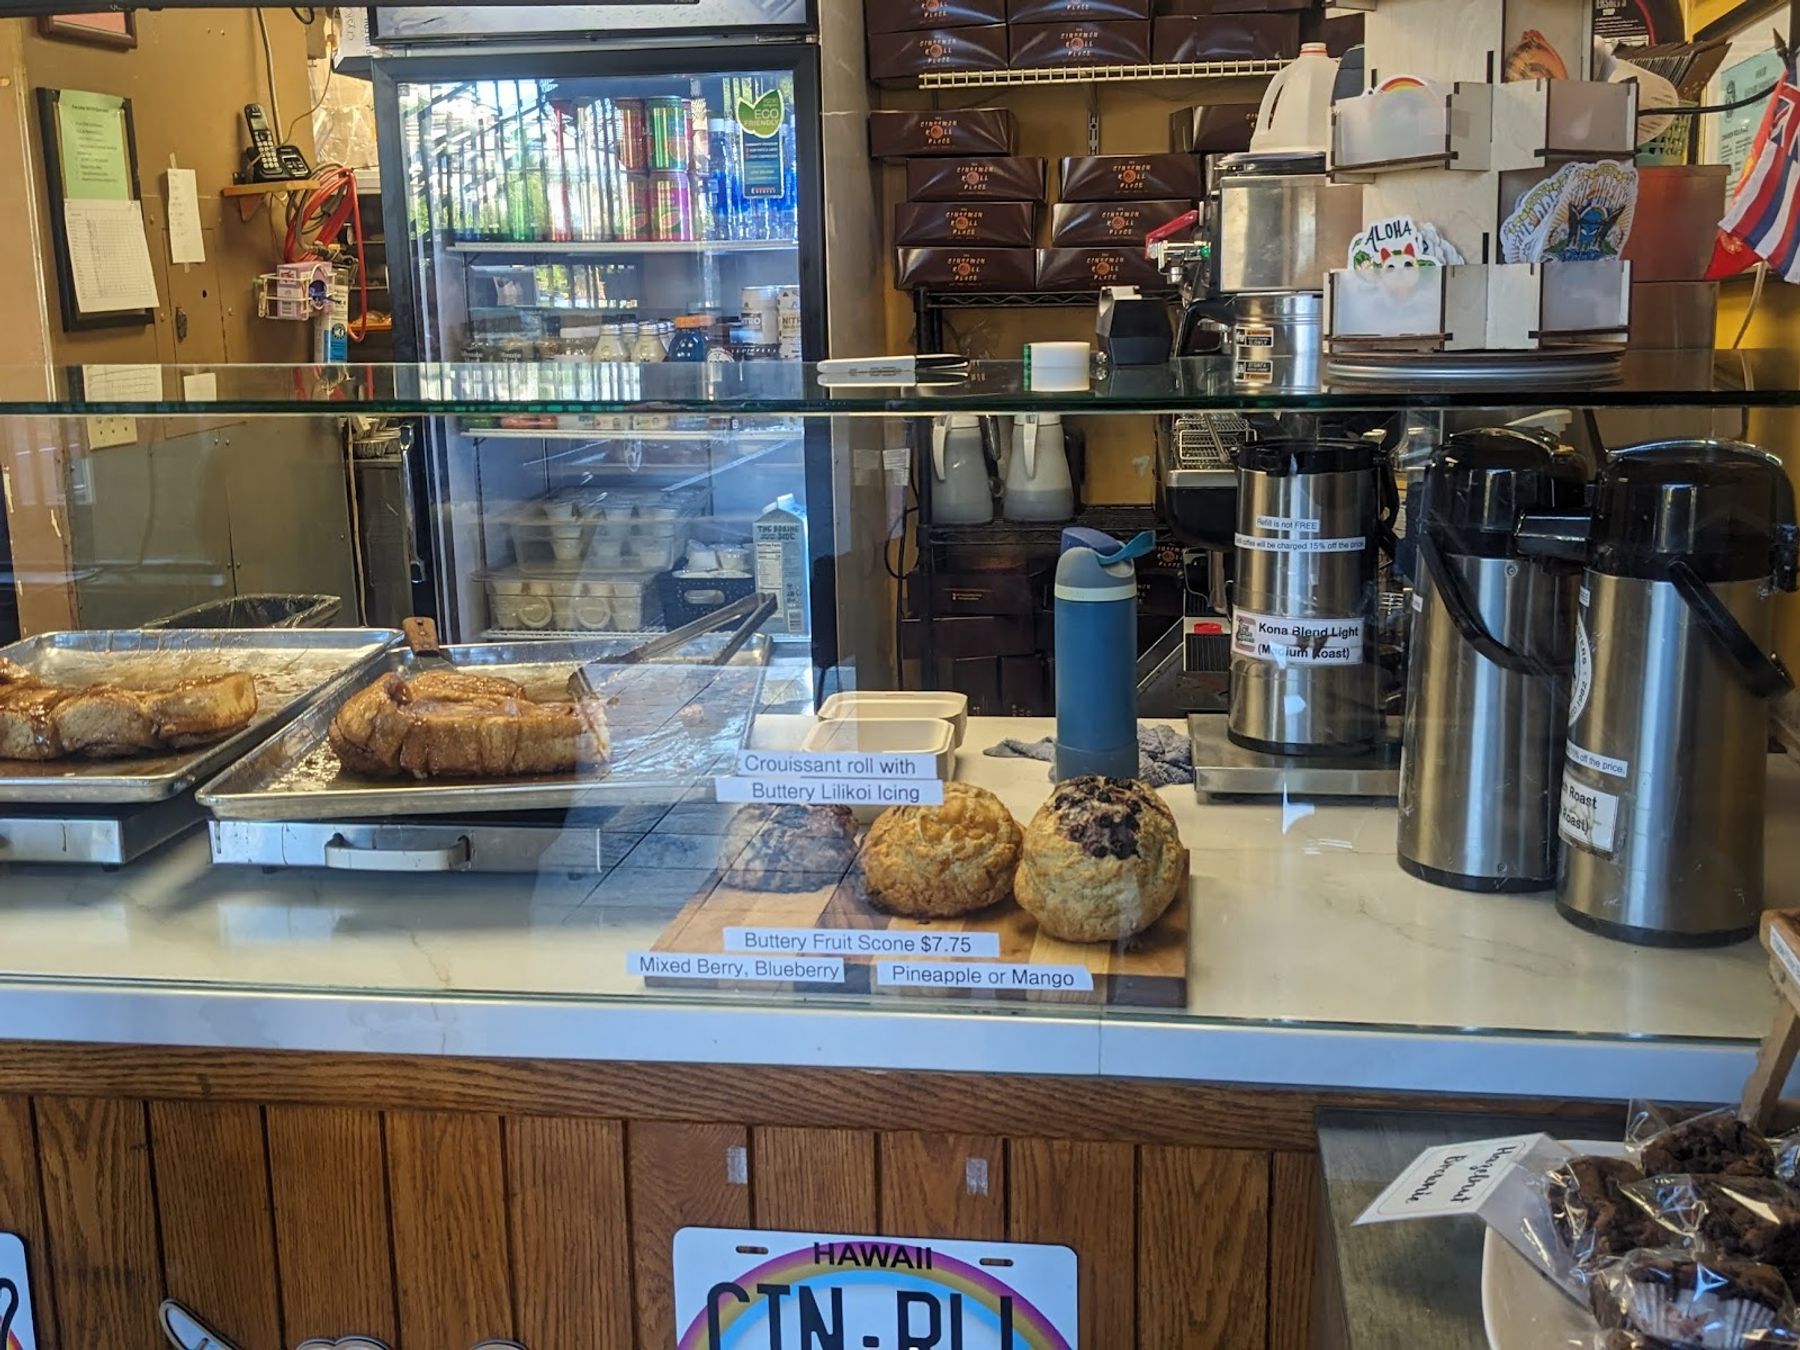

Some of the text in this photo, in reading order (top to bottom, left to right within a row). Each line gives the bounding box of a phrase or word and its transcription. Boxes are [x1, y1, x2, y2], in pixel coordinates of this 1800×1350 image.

[754, 108, 779, 119] ECO
[1364, 219, 1412, 252] ALOHA
[1281, 520, 1293, 529] not
[1294, 520, 1318, 531] FREE
[1266, 541, 1276, 549] be
[1277, 541, 1308, 551] charged
[1309, 542, 1326, 550] 15%
[1327, 542, 1338, 550] off
[1339, 541, 1350, 549] the
[1258, 622, 1288, 635] Kona
[1292, 626, 1328, 638] Blend
[1331, 627, 1359, 640] Light
[1257, 643, 1350, 660] (Mium oast)
[745, 755, 916, 775] Crouissant roll with
[752, 782, 920, 803] Buttery Lilikoi Icing
[1569, 785, 1598, 809] Roast
[745, 932, 972, 953] Buttery Fruit Scone $7.75
[640, 956, 840, 979] Mixed Berry, Blueberry
[892, 966, 1075, 988] Pineapple or Mango
[813, 1241, 932, 1270] HAWAII
